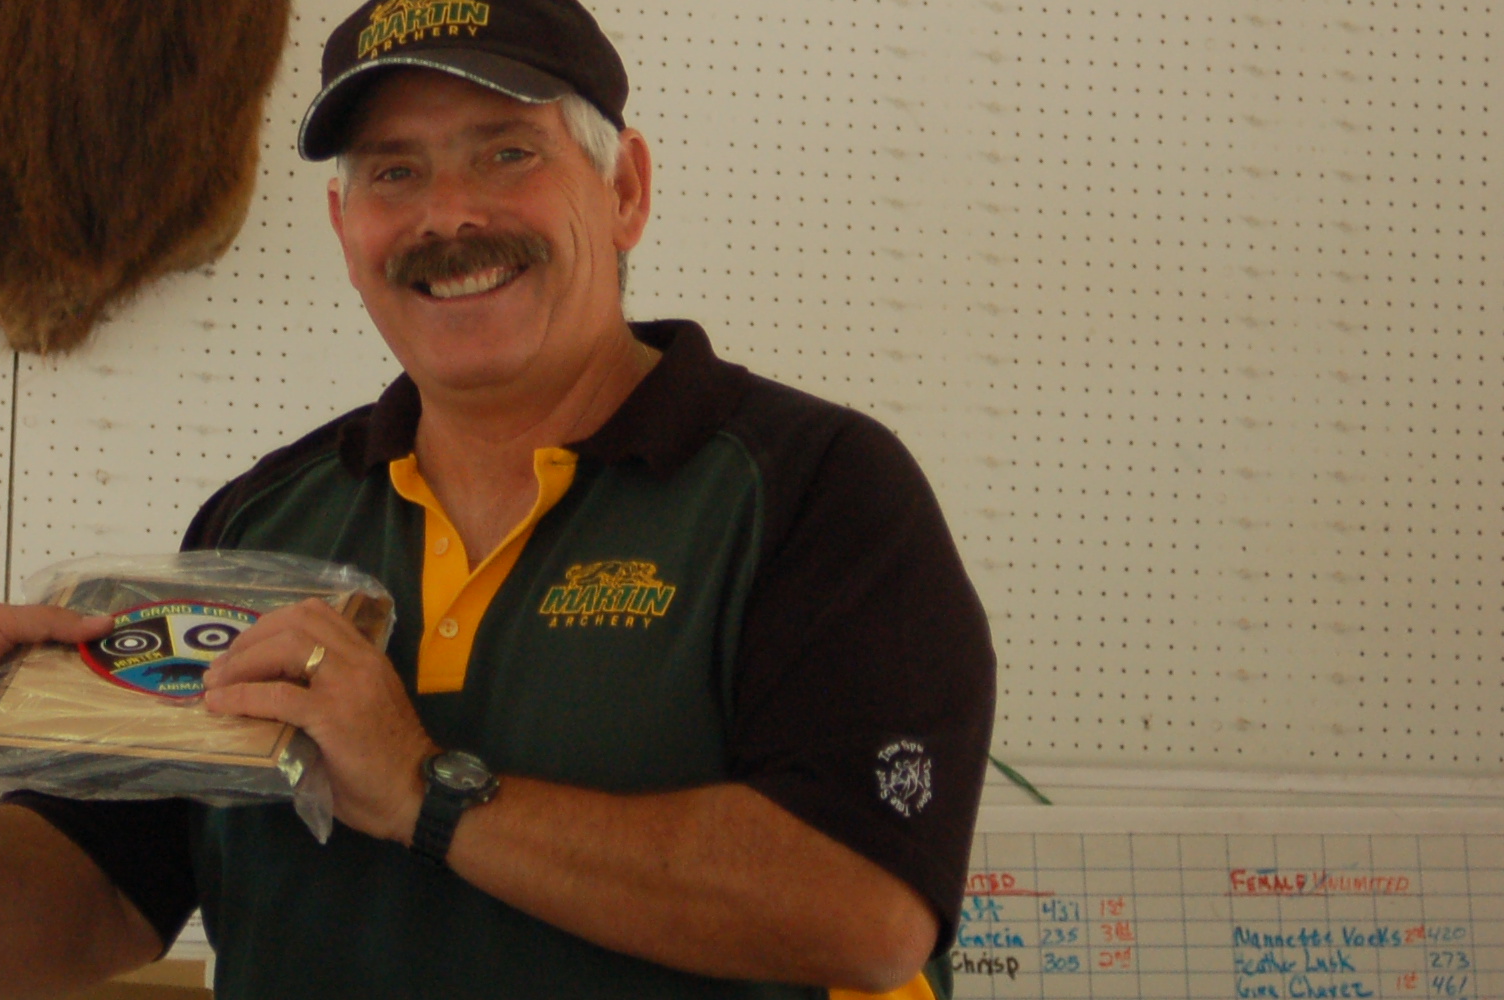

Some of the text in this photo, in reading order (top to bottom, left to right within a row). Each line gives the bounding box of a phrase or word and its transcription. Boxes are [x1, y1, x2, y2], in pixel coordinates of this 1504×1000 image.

[357, 0, 490, 60] MARTIN
[369, 25, 479, 60] ARCHERY
[538, 583, 677, 617] MARTIN
[140, 604, 249, 622] GRAND FIELD
[548, 614, 652, 630] ARCHERY
[113, 651, 165, 669] HUNTER
[1428, 950, 1471, 969] 273
